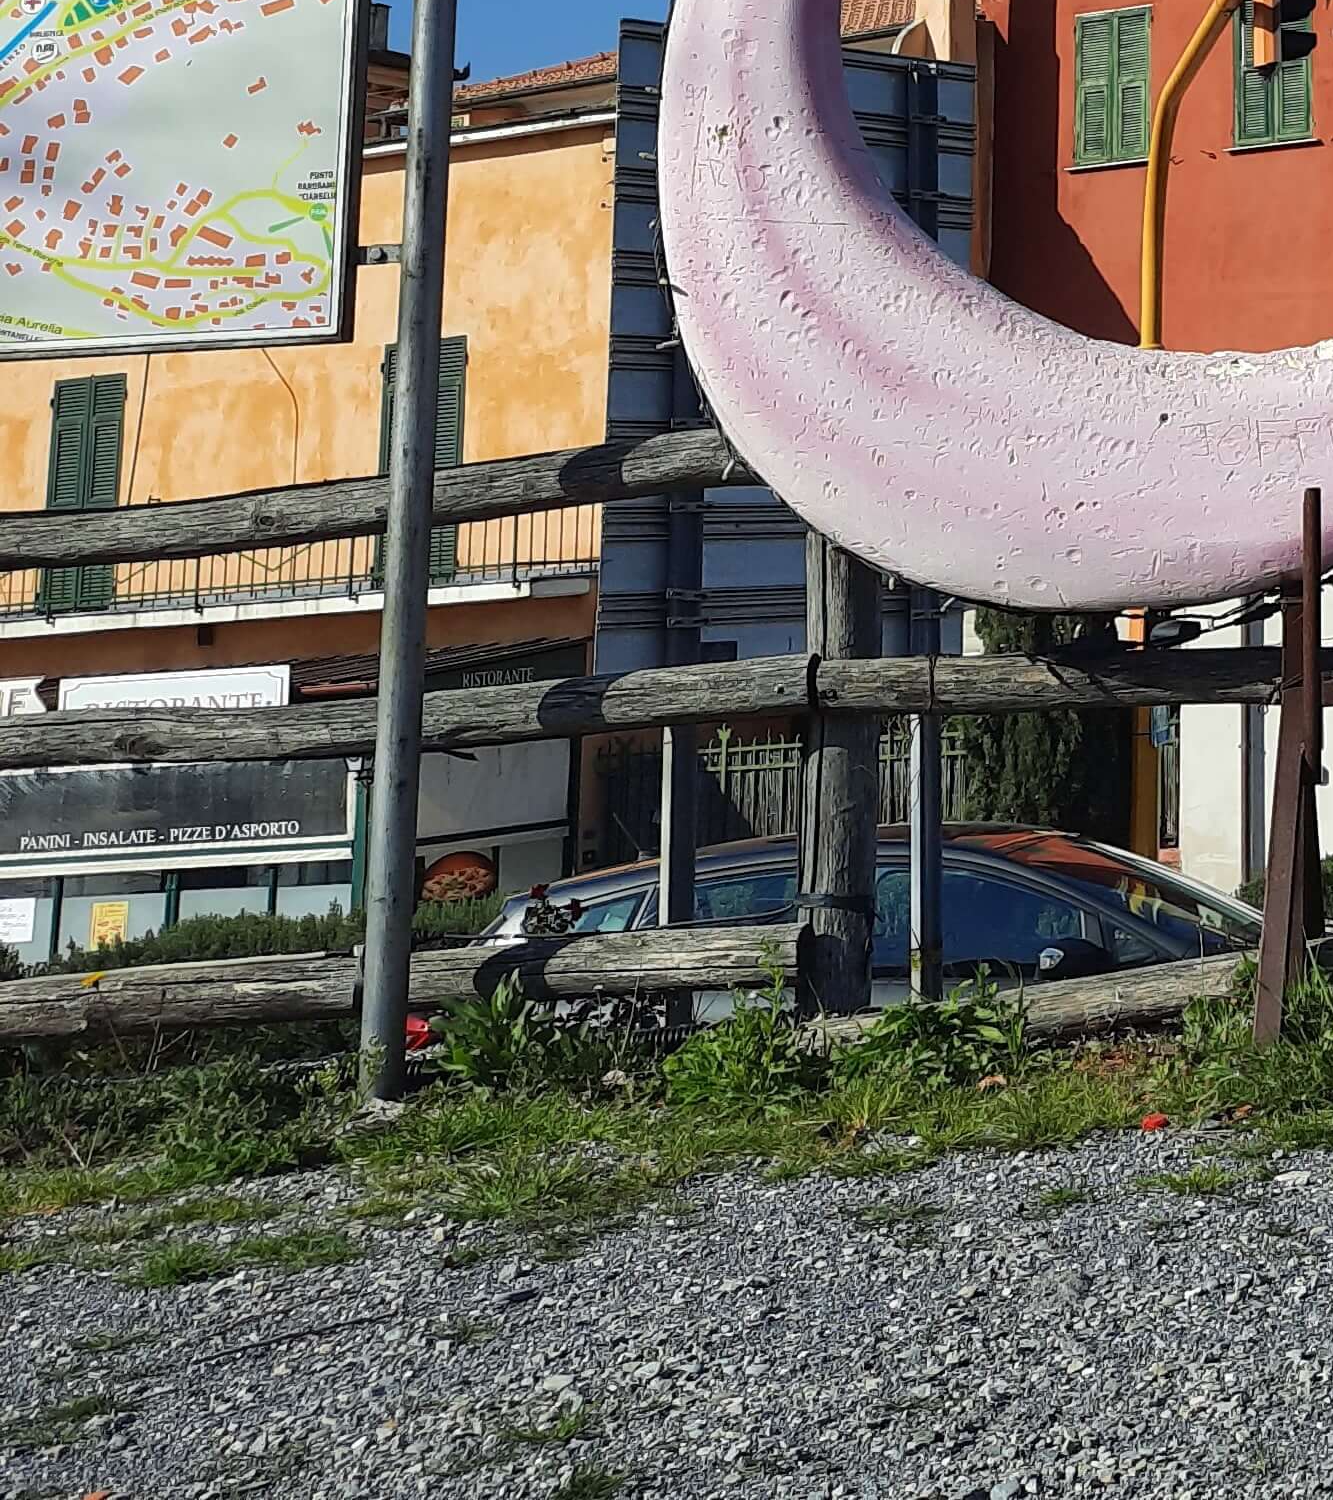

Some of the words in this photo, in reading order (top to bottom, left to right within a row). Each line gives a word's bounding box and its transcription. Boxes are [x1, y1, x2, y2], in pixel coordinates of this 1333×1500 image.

[16, 316, 63, 336] Aurelia
[462, 667, 535, 688] RISTORANTE
[20, 833, 71, 850] PANINI
[82, 828, 157, 847] INSALATE
[169, 825, 213, 842] PIZZE
[215, 820, 300, 840] D'ASPORTO
